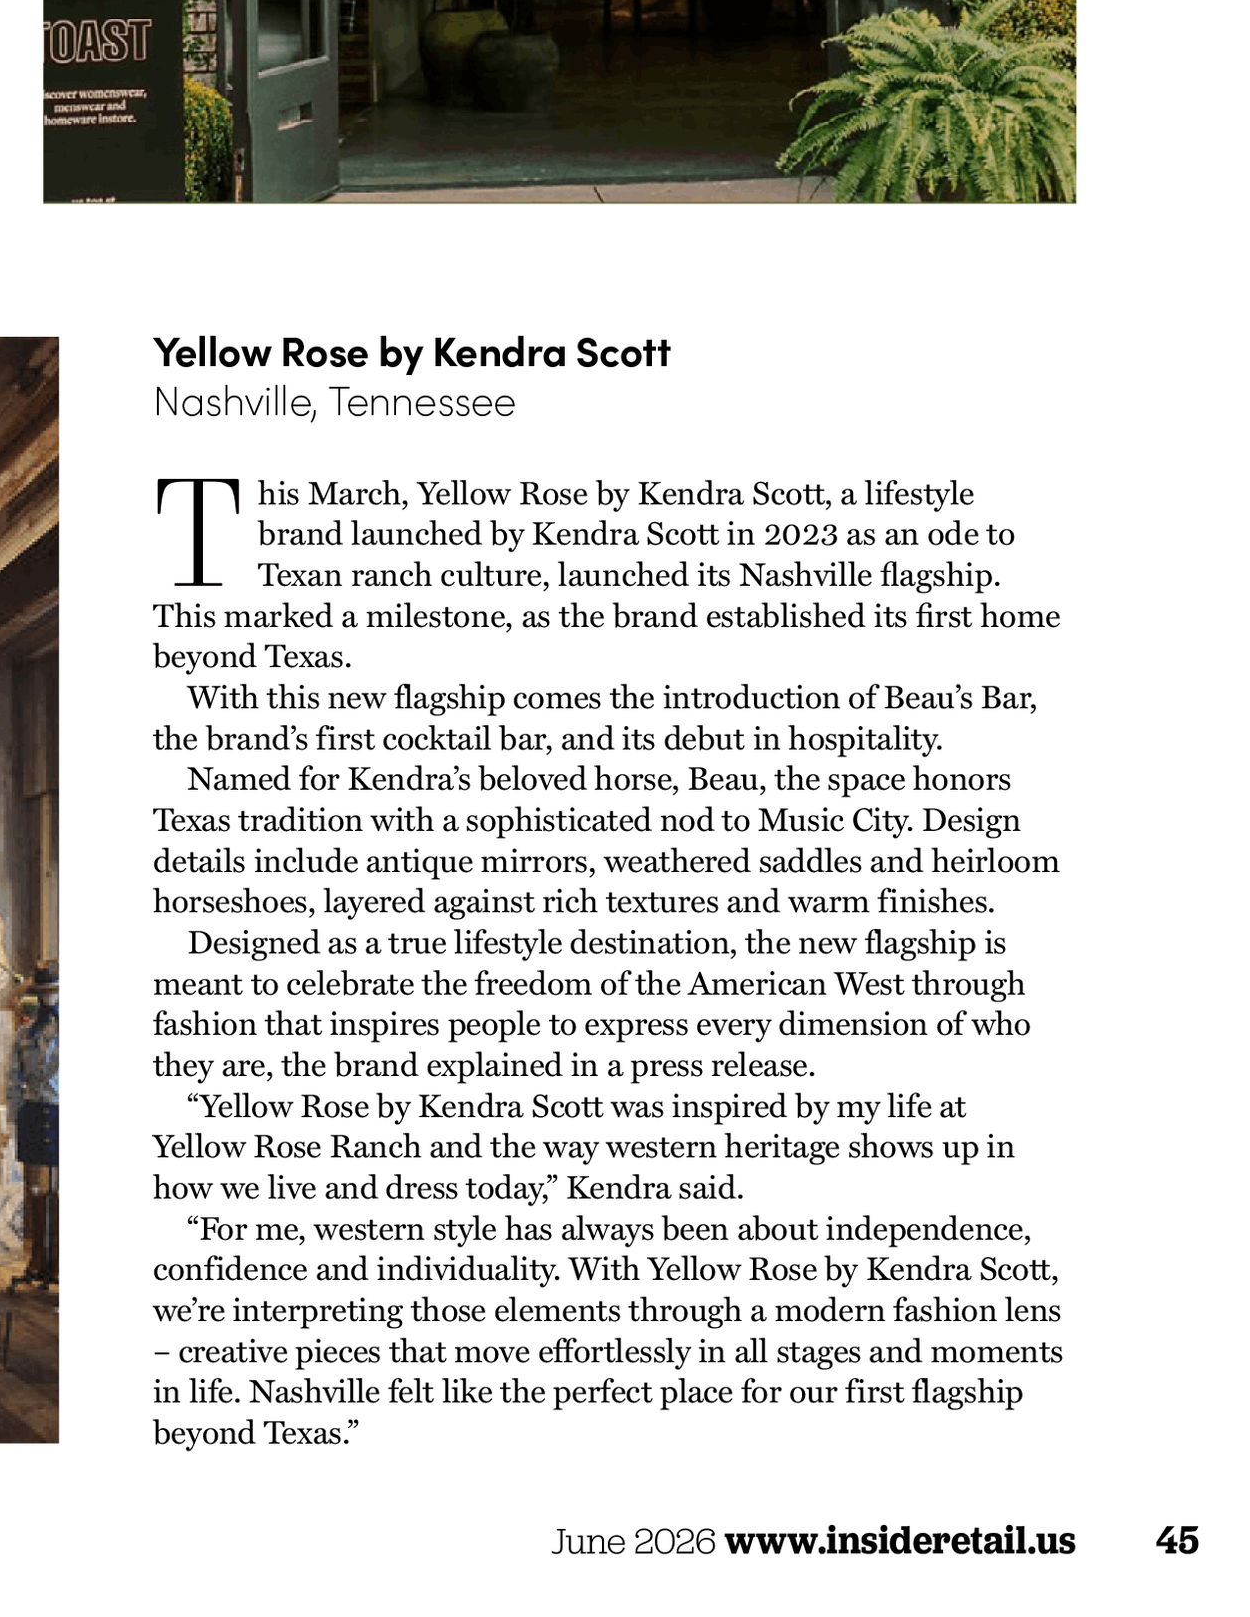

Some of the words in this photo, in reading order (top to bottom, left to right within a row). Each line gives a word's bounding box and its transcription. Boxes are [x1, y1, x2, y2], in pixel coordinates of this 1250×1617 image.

[43, 18, 152, 64] OAST
[43, 89, 77, 100] scover
[78, 88, 147, 99] womenswear,
[53, 103, 104, 114] menswear
[106, 99, 126, 111] and
[43, 114, 97, 126] homeware
[98, 112, 137, 124] instore.
[153, 336, 272, 367] Yellow
[283, 338, 368, 367] Rose
[381, 336, 424, 375] by
[435, 336, 565, 367] Kendra
[577, 338, 671, 367] Scott
[157, 385, 316, 423] Nashville,
[329, 387, 515, 416] Tennessee
[309, 480, 407, 510] March,
[417, 480, 511, 505] Yellow
[520, 482, 587, 505] Rose
[596, 480, 629, 512] by
[639, 480, 744, 505] Kendra
[753, 482, 831, 510] Scott,
[841, 489, 857, 505] a
[865, 480, 973, 512] lifestyle
[258, 563, 342, 586] Texan
[352, 561, 432, 586] ranch
[441, 561, 549, 591] culture,
[558, 561, 689, 586] launched
[698, 562, 730, 586] its
[740, 561, 872, 586] Nashville
[880, 561, 1000, 593] flagship.
[153, 725, 197, 750] the
[206, 725, 307, 750] brand’s
[316, 725, 375, 750] first
[383, 725, 491, 750] cocktail
[499, 725, 552, 755] bar,
[562, 725, 614, 750] and
[622, 726, 654, 750] its
[665, 725, 745, 750] debut
[754, 726, 780, 750] in
[789, 725, 942, 757] hospitality.
[153, 888, 314, 917] horseshoes,
[324, 888, 425, 920] layered
[434, 889, 535, 920] against
[543, 888, 598, 913] rich
[606, 892, 718, 913] textures
[728, 888, 780, 913] and
[788, 897, 869, 913] warm
[878, 888, 994, 913] finishes.
[153, 1052, 214, 1083] they
[223, 1060, 272, 1081] are,
[281, 1052, 326, 1076] the
[334, 1052, 418, 1077] brand
[428, 1052, 562, 1083] explained
[571, 1052, 598, 1076] in
[608, 1060, 624, 1077] a
[631, 1060, 703, 1083] press
[712, 1052, 814, 1077] release.
[153, 1174, 213, 1199] how
[221, 1183, 259, 1199] we
[268, 1174, 316, 1199] live
[326, 1174, 378, 1199] and
[386, 1174, 457, 1199] dress
[466, 1174, 557, 1206] today,”
[567, 1174, 672, 1199] Kendra
[679, 1174, 743, 1199] said.
[188, 1216, 247, 1240] “For
[256, 1224, 305, 1245] me,
[314, 1220, 424, 1240] western
[434, 1215, 496, 1247] style
[505, 1215, 552, 1240] has
[562, 1215, 654, 1247] always
[662, 1215, 728, 1240] been
[738, 1215, 818, 1241] about
[826, 1215, 1030, 1247] independence,
[153, 1419, 255, 1451] beyond
[264, 1419, 358, 1444] Texas.”
[552, 1529, 625, 1554] June
[635, 1528, 715, 1554] 2026
[724, 1525, 1075, 1554] www.insideretail.us
[1156, 1526, 1199, 1554] 45
